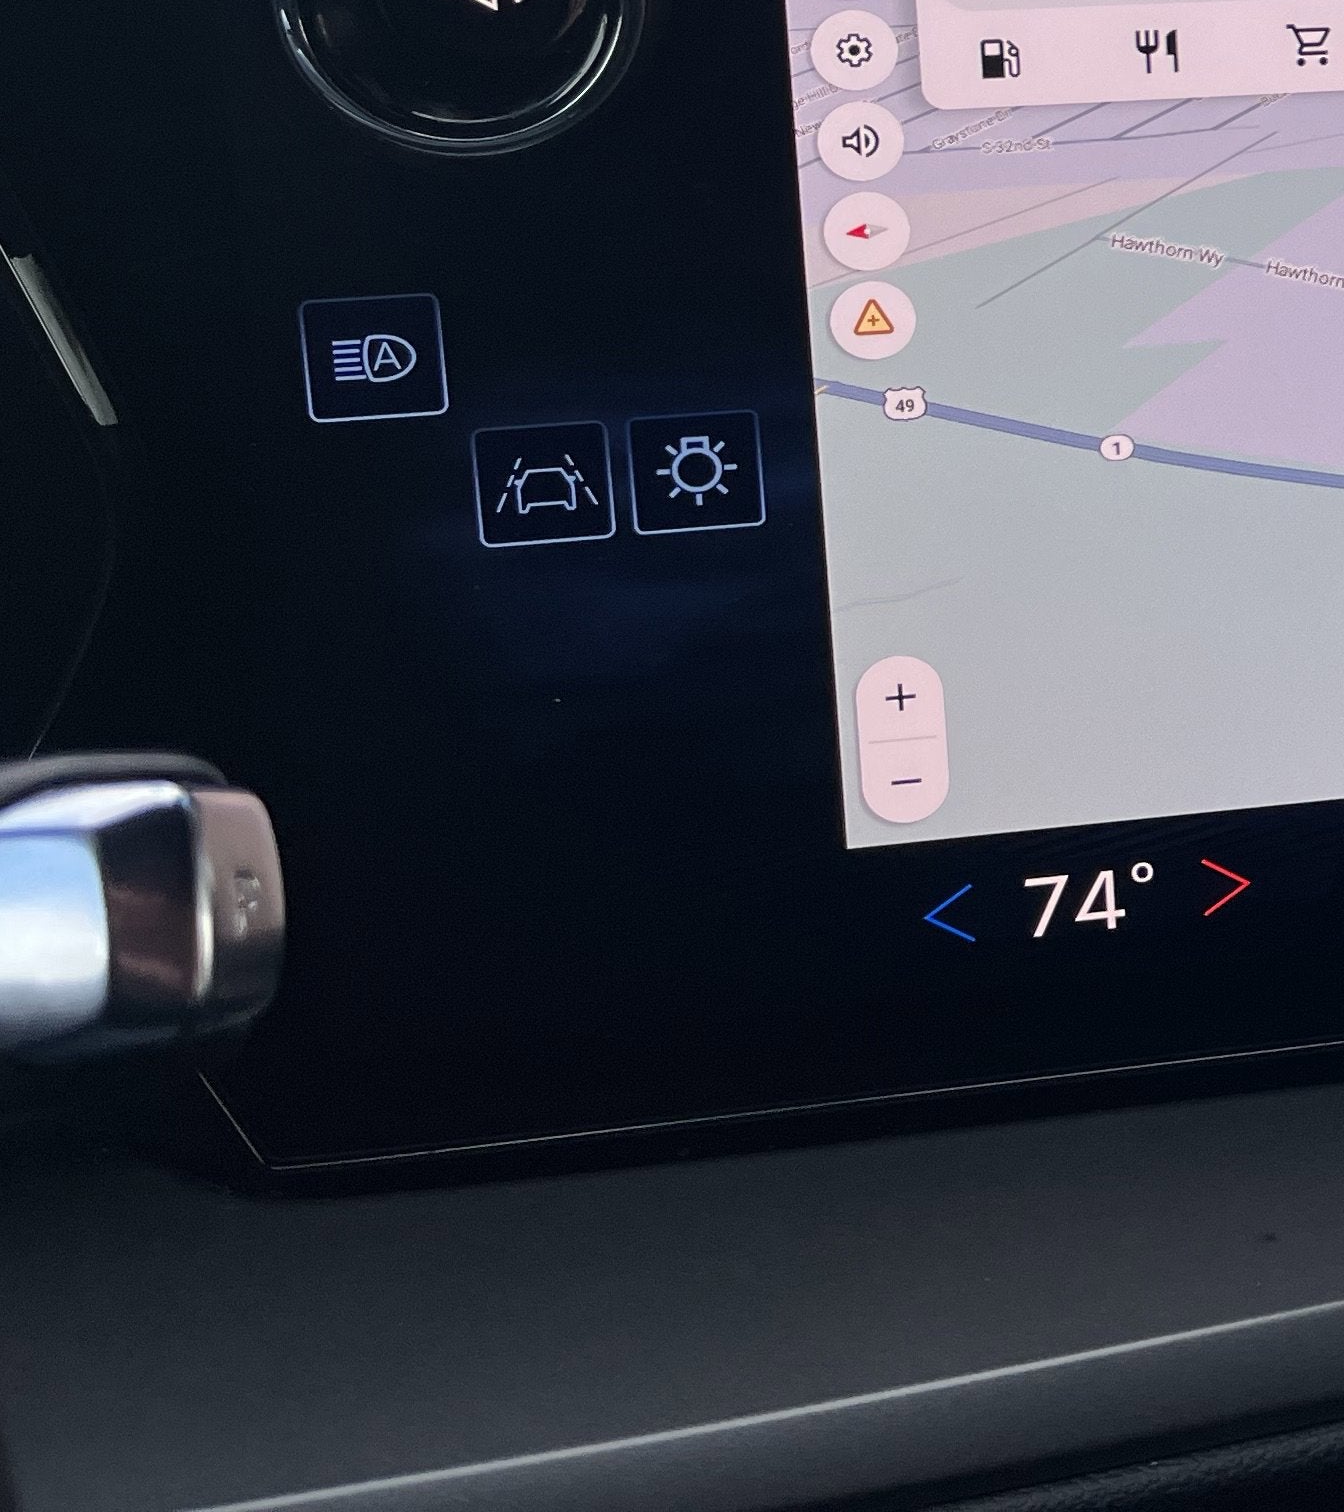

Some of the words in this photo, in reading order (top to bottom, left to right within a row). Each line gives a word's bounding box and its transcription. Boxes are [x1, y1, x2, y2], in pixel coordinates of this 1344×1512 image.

[1111, 234, 1193, 261] Hawthorn
[1199, 247, 1225, 268] Wy
[895, 398, 915, 413] 49
[1111, 441, 1121, 456] 1
[1024, 861, 1154, 938] 74°
